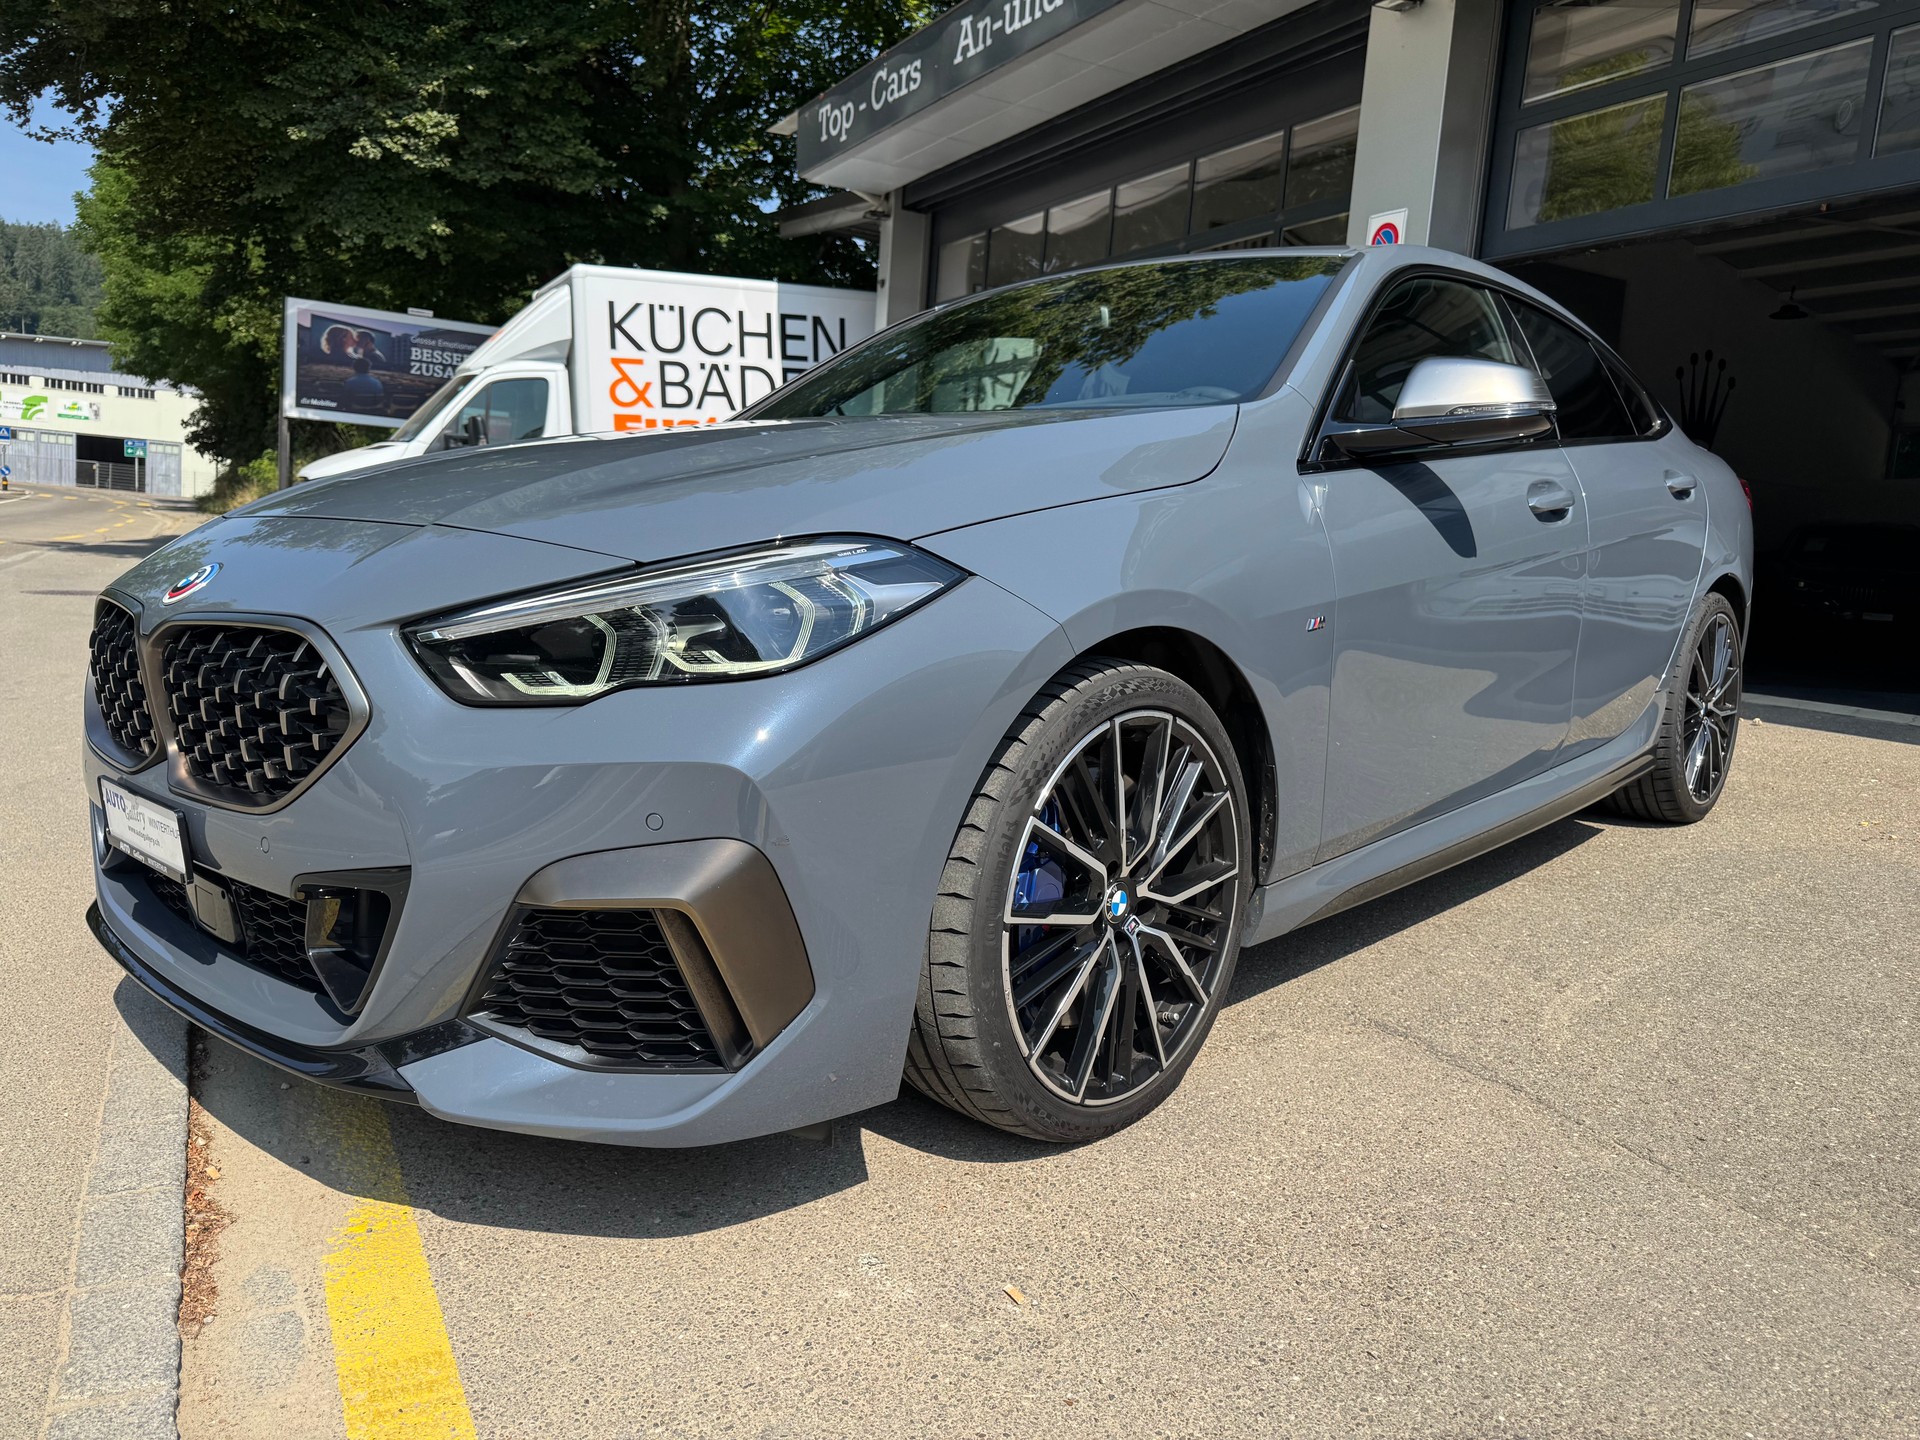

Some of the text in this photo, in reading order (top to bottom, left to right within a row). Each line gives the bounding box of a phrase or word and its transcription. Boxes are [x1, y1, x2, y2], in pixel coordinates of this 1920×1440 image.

[818, 101, 855, 142] Top
[871, 58, 922, 111] Cars
[608, 301, 846, 363] KÜCHEN
[106, 788, 126, 813] AUTO
